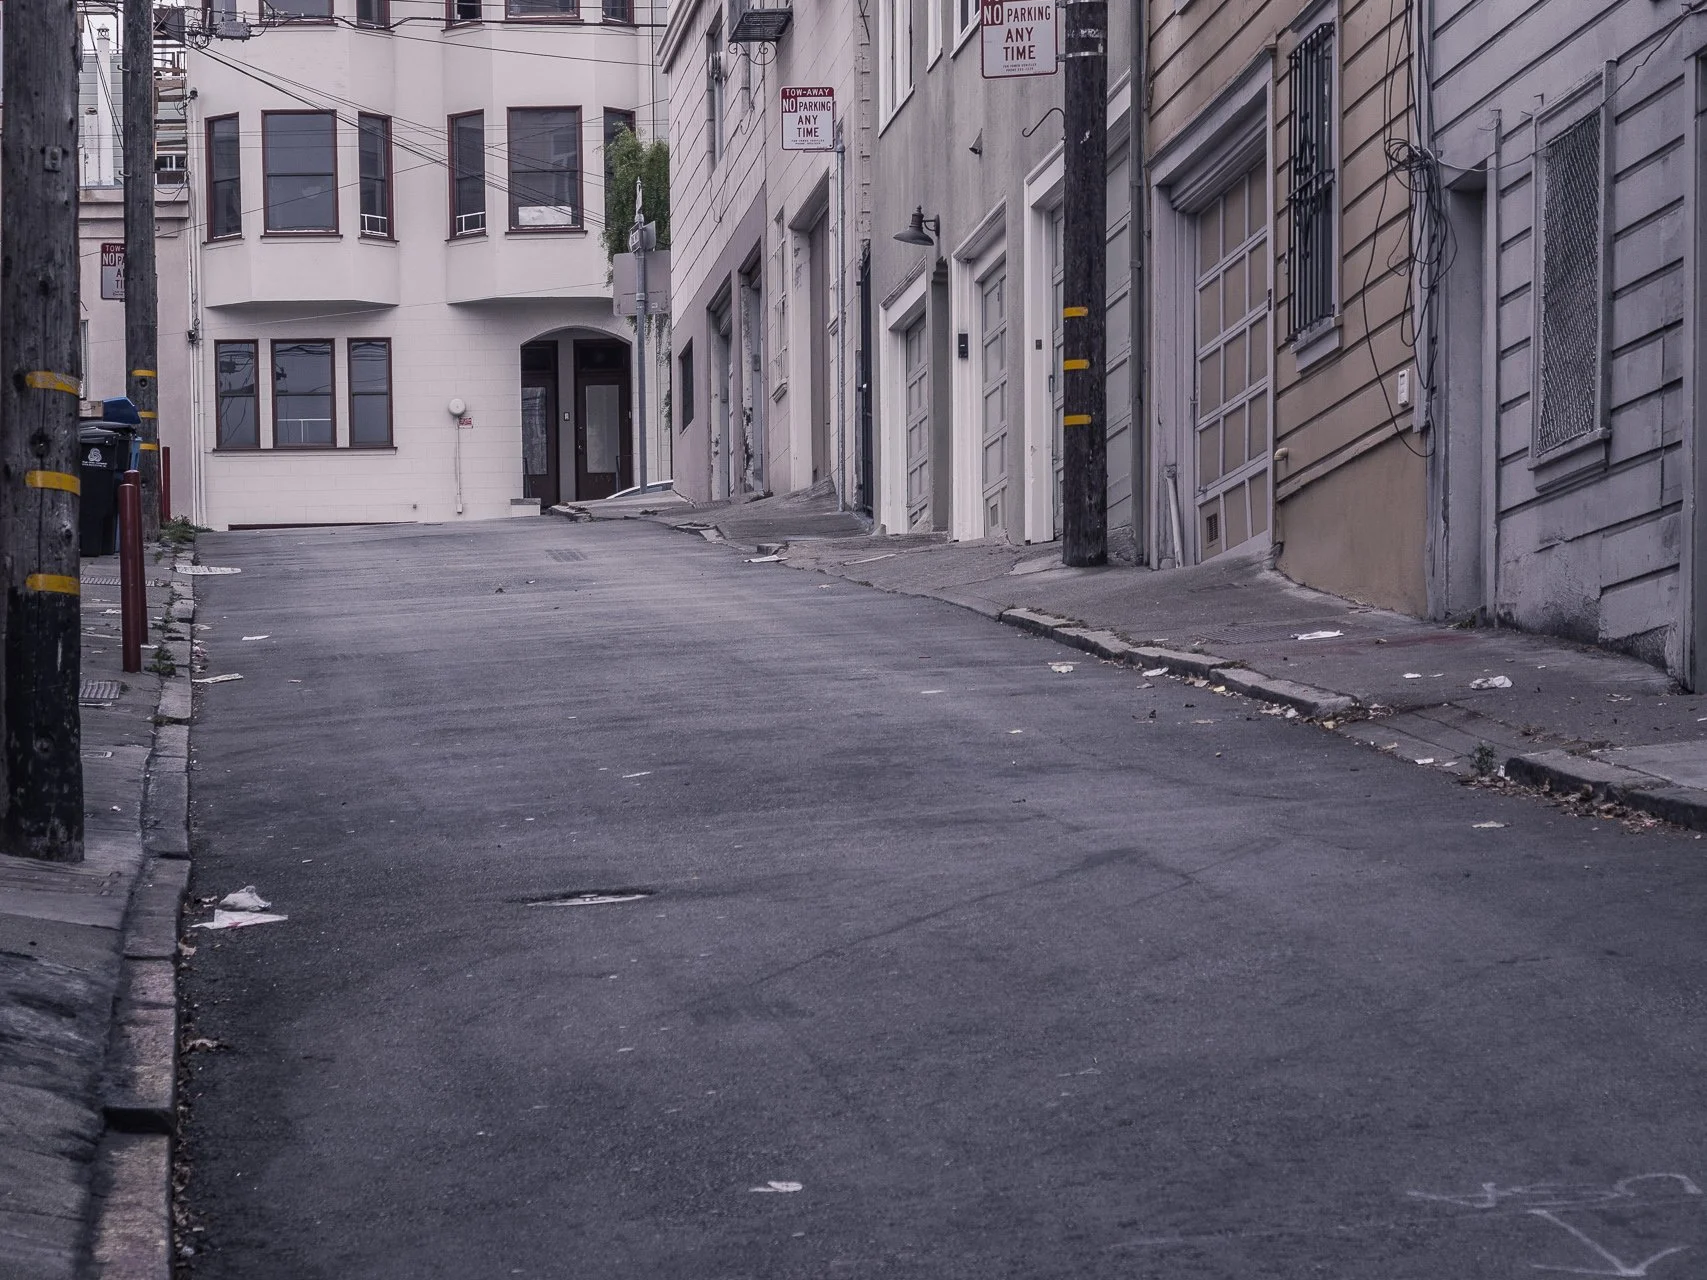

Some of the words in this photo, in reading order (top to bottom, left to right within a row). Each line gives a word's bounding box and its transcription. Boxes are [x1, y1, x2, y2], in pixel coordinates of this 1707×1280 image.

[983, 4, 1002, 25] NO
[1007, 5, 1051, 23] PARKING
[1005, 26, 1034, 43] ANY
[1002, 45, 1036, 61] TIME
[785, 88, 830, 96] TOW-AWAY
[782, 98, 796, 112] NO
[798, 101, 831, 112] PARKING
[797, 114, 818, 125] ANY
[796, 127, 819, 138] TIME
[105, 244, 125, 252] TOW-
[102, 252, 115, 266] NO
